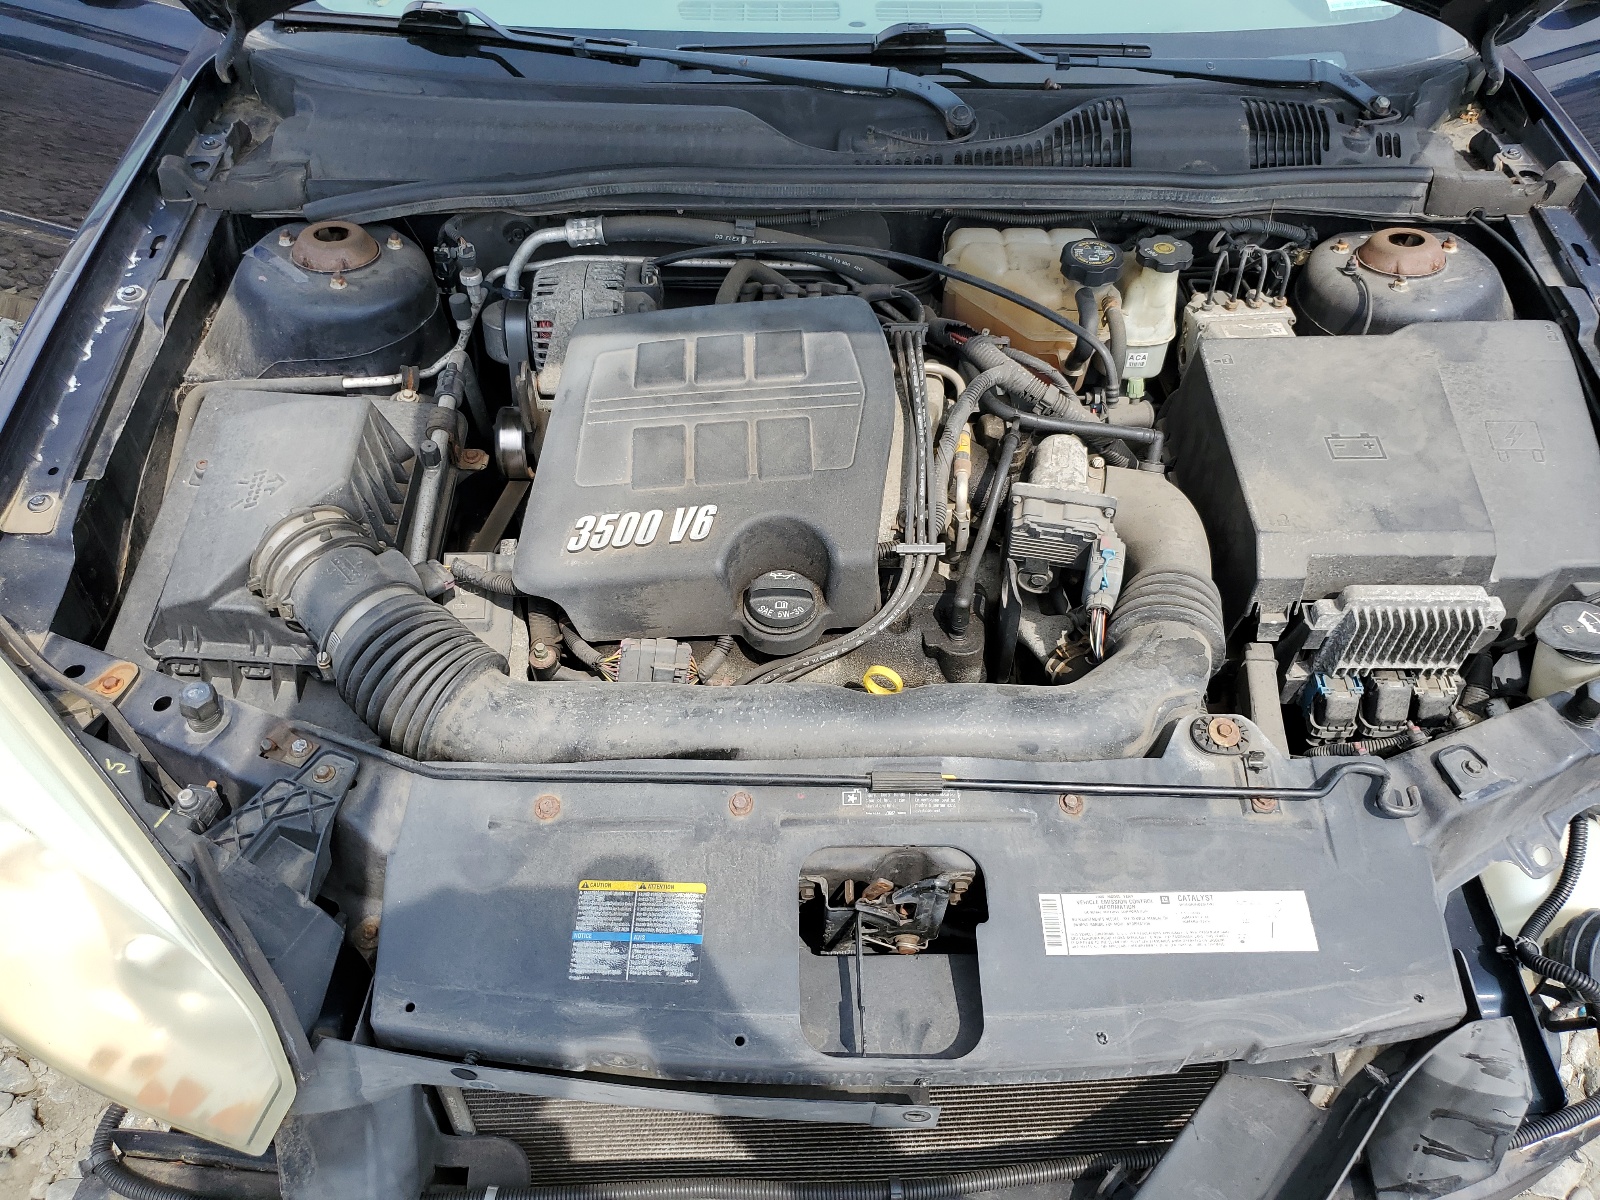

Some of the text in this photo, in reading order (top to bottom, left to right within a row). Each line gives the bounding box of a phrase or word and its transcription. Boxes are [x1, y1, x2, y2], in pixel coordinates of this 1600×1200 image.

[566, 504, 718, 554] 3500 V6
[757, 605, 805, 618] SAE 5W-30
[1177, 894, 1214, 902] CATALYST
